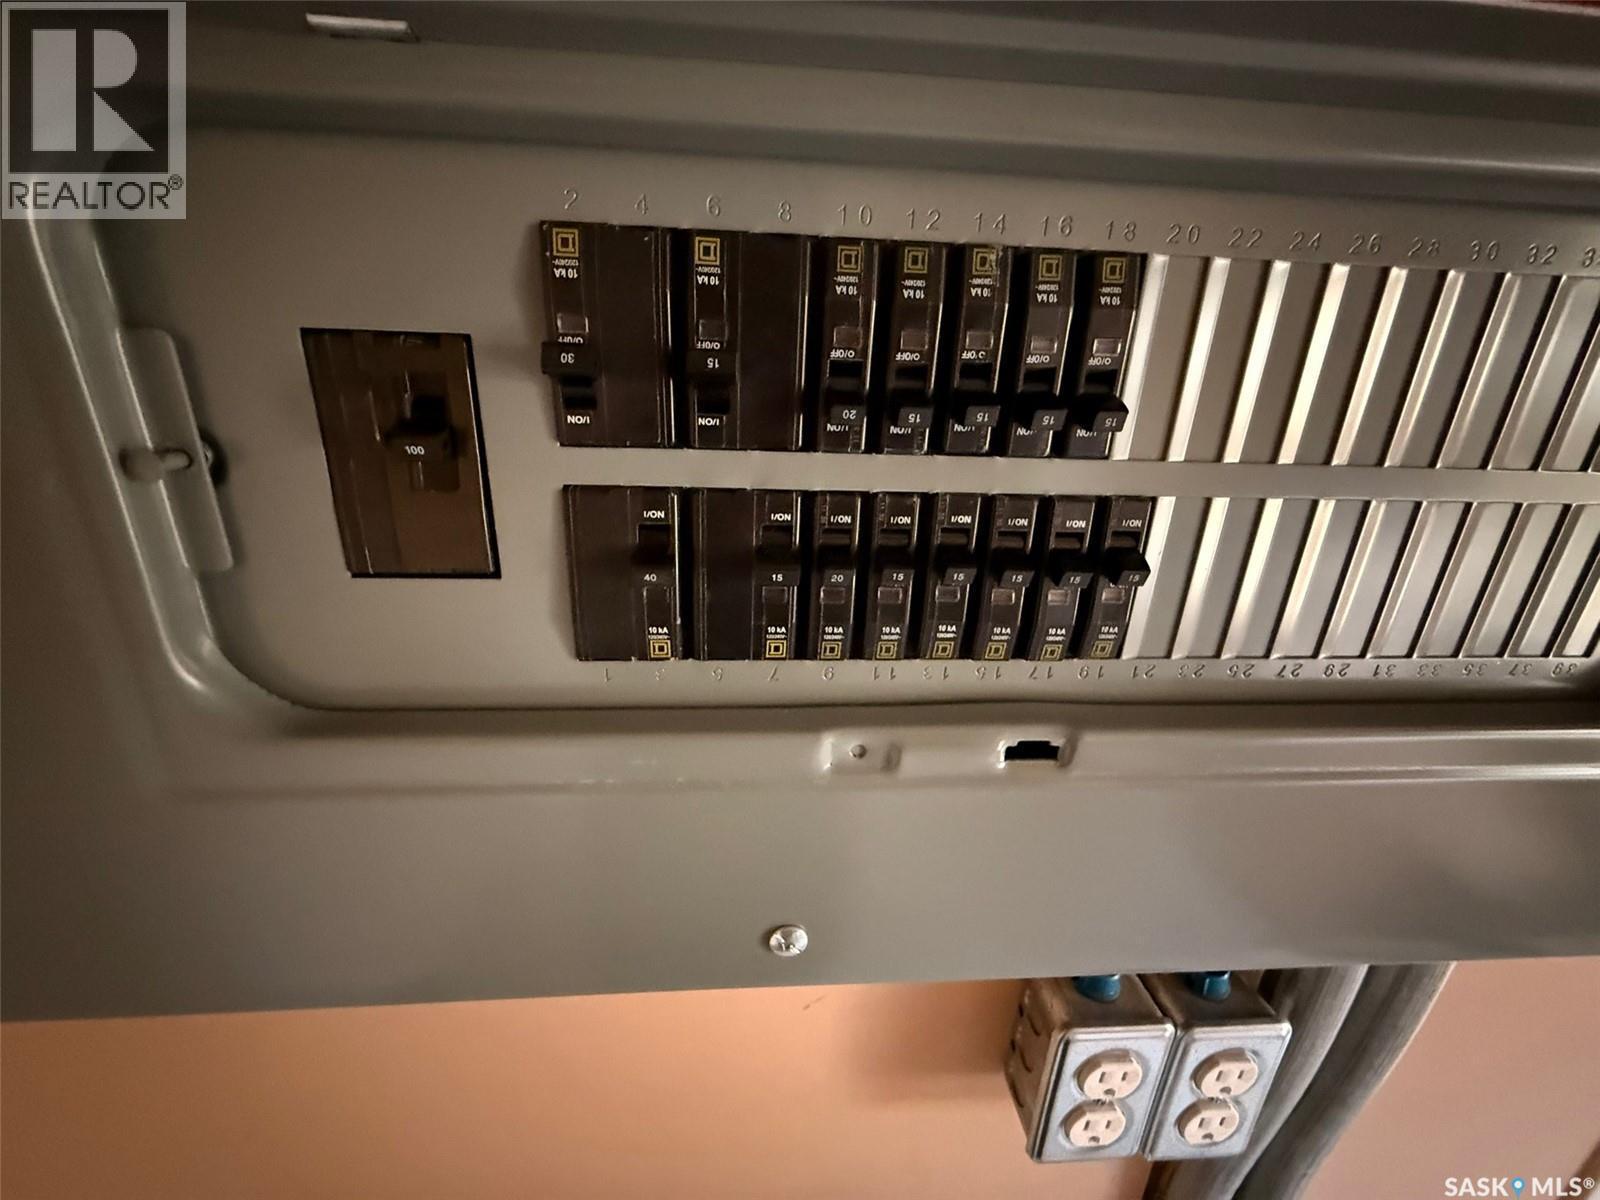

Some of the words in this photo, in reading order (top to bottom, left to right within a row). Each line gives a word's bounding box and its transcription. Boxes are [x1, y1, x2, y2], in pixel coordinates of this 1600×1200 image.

[563, 187, 579, 209] 2
[633, 193, 649, 215] 4
[705, 193, 721, 217] 6
[777, 200, 792, 222] 8
[837, 203, 873, 227] 10
[905, 207, 941, 231] 12
[973, 211, 1007, 235] 14
[1040, 215, 1074, 237] 16
[1105, 220, 1137, 242] 18
[1166, 223, 1201, 245] 20
[1228, 227, 1263, 248] 22
[1289, 230, 1322, 251] 24
[1348, 232, 1383, 255] 26
[1407, 236, 1441, 257] 28
[1470, 239, 1500, 262] 30
[1527, 243, 1558, 265] 32
[1581, 246, 1600, 269] 3
[554, 268, 566, 277] kA
[568, 268, 578, 278] 10
[697, 275, 708, 285] kA
[710, 276, 719, 285] 10
[835, 284, 847, 294] kA
[848, 286, 857, 295] 10
[903, 289, 914, 298] kA
[971, 288, 981, 296] kA
[916, 290, 924, 299] 10
[1037, 293, 1047, 303] kA
[1049, 294, 1057, 303] 10
[1100, 296, 1110, 305] kA
[1112, 296, 1120, 305] 10
[561, 353, 574, 363] 30
[707, 358, 719, 368] 15
[843, 410, 856, 419] 20
[909, 414, 920, 423] 15
[977, 413, 988, 422] 15
[567, 415, 590, 424] I/ON
[1042, 416, 1054, 425] 15
[1105, 418, 1117, 427] 15
[405, 446, 424, 455] 100
[771, 513, 791, 521] I/ON
[831, 515, 851, 523] I/ON
[891, 516, 911, 524] I/ON
[1066, 520, 1086, 528] I/ON
[893, 573, 904, 581] 15
[954, 573, 964, 581] 15
[1070, 576, 1080, 584] 15
[1101, 626, 1109, 634] 10
[767, 667, 780, 682] 7
[822, 667, 834, 680] 9
[872, 667, 896, 680] 11
[923, 667, 949, 680] 13
[975, 666, 1001, 680] 15
[1029, 666, 1054, 680] 17
[1078, 665, 1104, 680] 19
[1131, 664, 1156, 679] 21
[1178, 663, 1206, 679] 23
[1227, 662, 1255, 679] 25
[1275, 662, 1304, 678] 27
[1323, 662, 1352, 678] 29
[1372, 663, 1397, 678] 31
[1417, 663, 1442, 677] 33
[1462, 662, 1488, 677] 35
[1508, 662, 1533, 677] 37
[1551, 661, 1578, 677] 39
